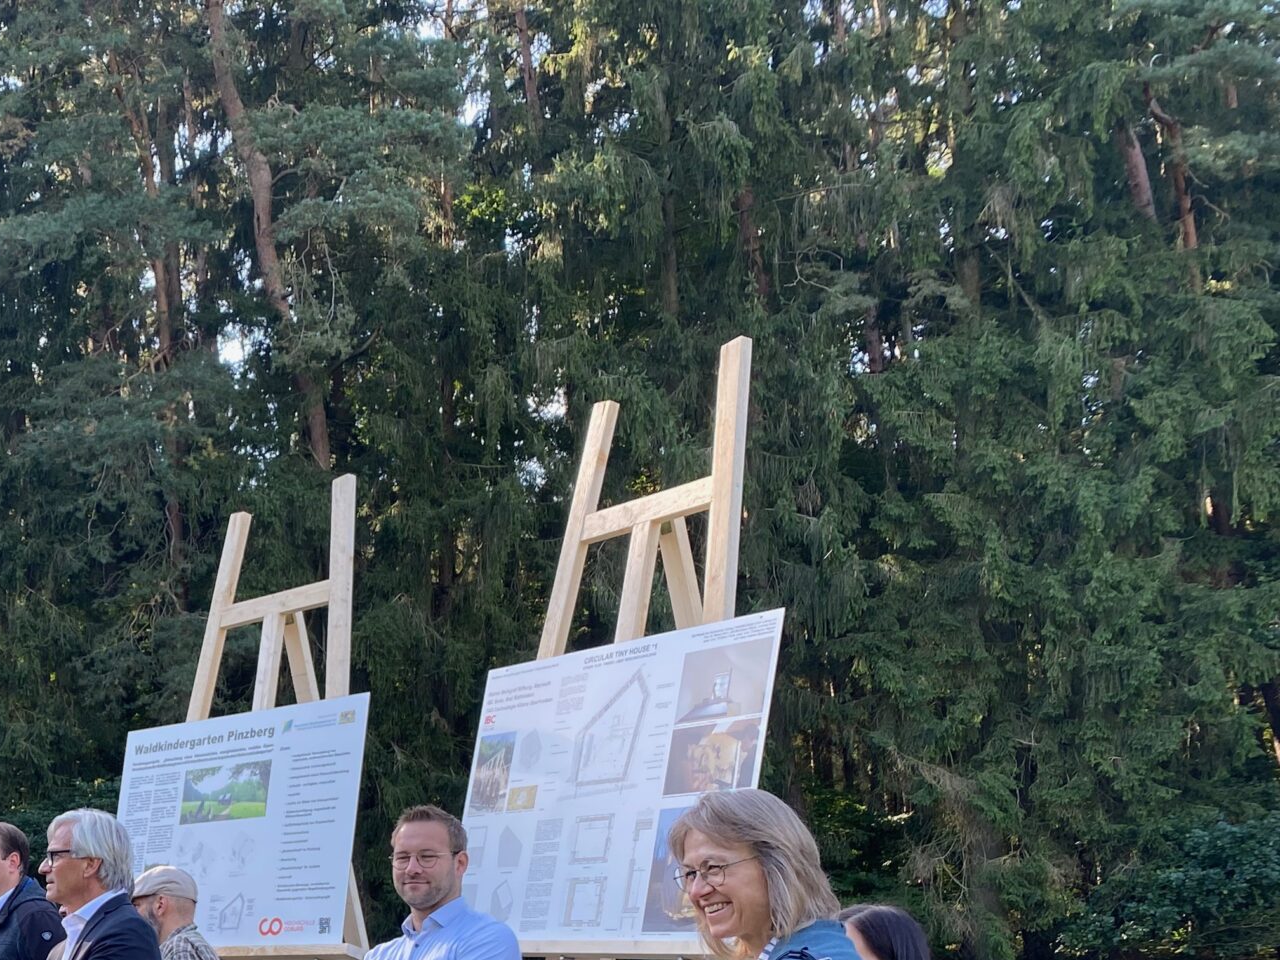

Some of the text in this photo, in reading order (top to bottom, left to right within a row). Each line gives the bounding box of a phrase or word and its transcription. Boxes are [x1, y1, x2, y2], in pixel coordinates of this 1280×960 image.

[584, 652, 614, 665] CIRCULAR
[615, 650, 629, 659] TINY
[630, 645, 650, 655] HOUSE
[134, 727, 275, 756] Waldkindergarten Pinzberg
